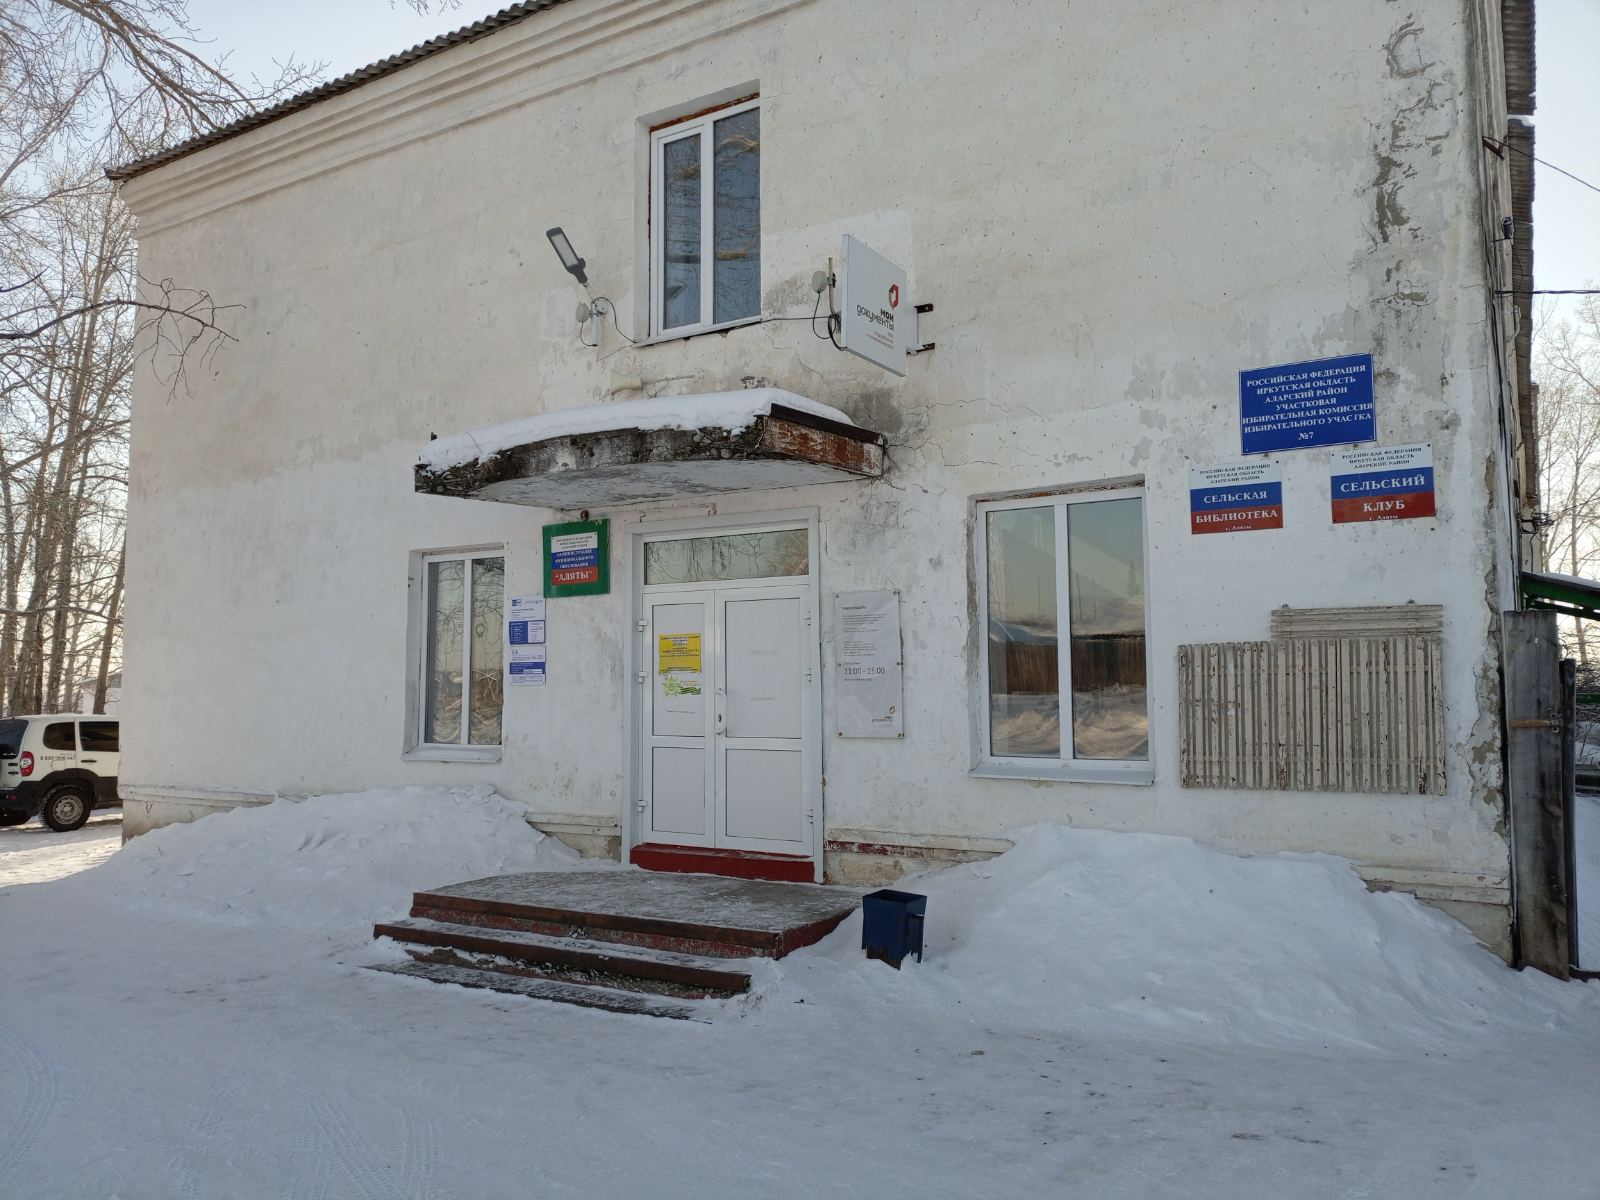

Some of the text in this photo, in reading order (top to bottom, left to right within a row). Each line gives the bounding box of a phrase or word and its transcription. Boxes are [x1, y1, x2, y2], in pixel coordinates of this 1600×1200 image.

[1246, 364, 1366, 388] РОССИЙСКАЯ ФЕДЕРАЦИЯ
[1256, 375, 1356, 396] ИРКУТСКАЯ ОБЛАСТЬ
[1264, 386, 1348, 404] АЛАРСКИЙ РАЙОН
[1276, 397, 1337, 411] УЧАСТКОВАЯ
[1242, 402, 1373, 425] ИЗБИРАТЕЛЬНАЯ КОМИССИЯ
[1244, 418, 1326, 434] ИЗБИРАТЕЛЬНОГО
[1298, 431, 1314, 441] №7
[1340, 474, 1425, 493] СЕЛЬСКИЙ
[1203, 491, 1267, 504] СЕЛЬСКАЯ
[1363, 499, 1405, 513] КЛУБ
[1196, 509, 1278, 524] БИБЛИОТЕКА
